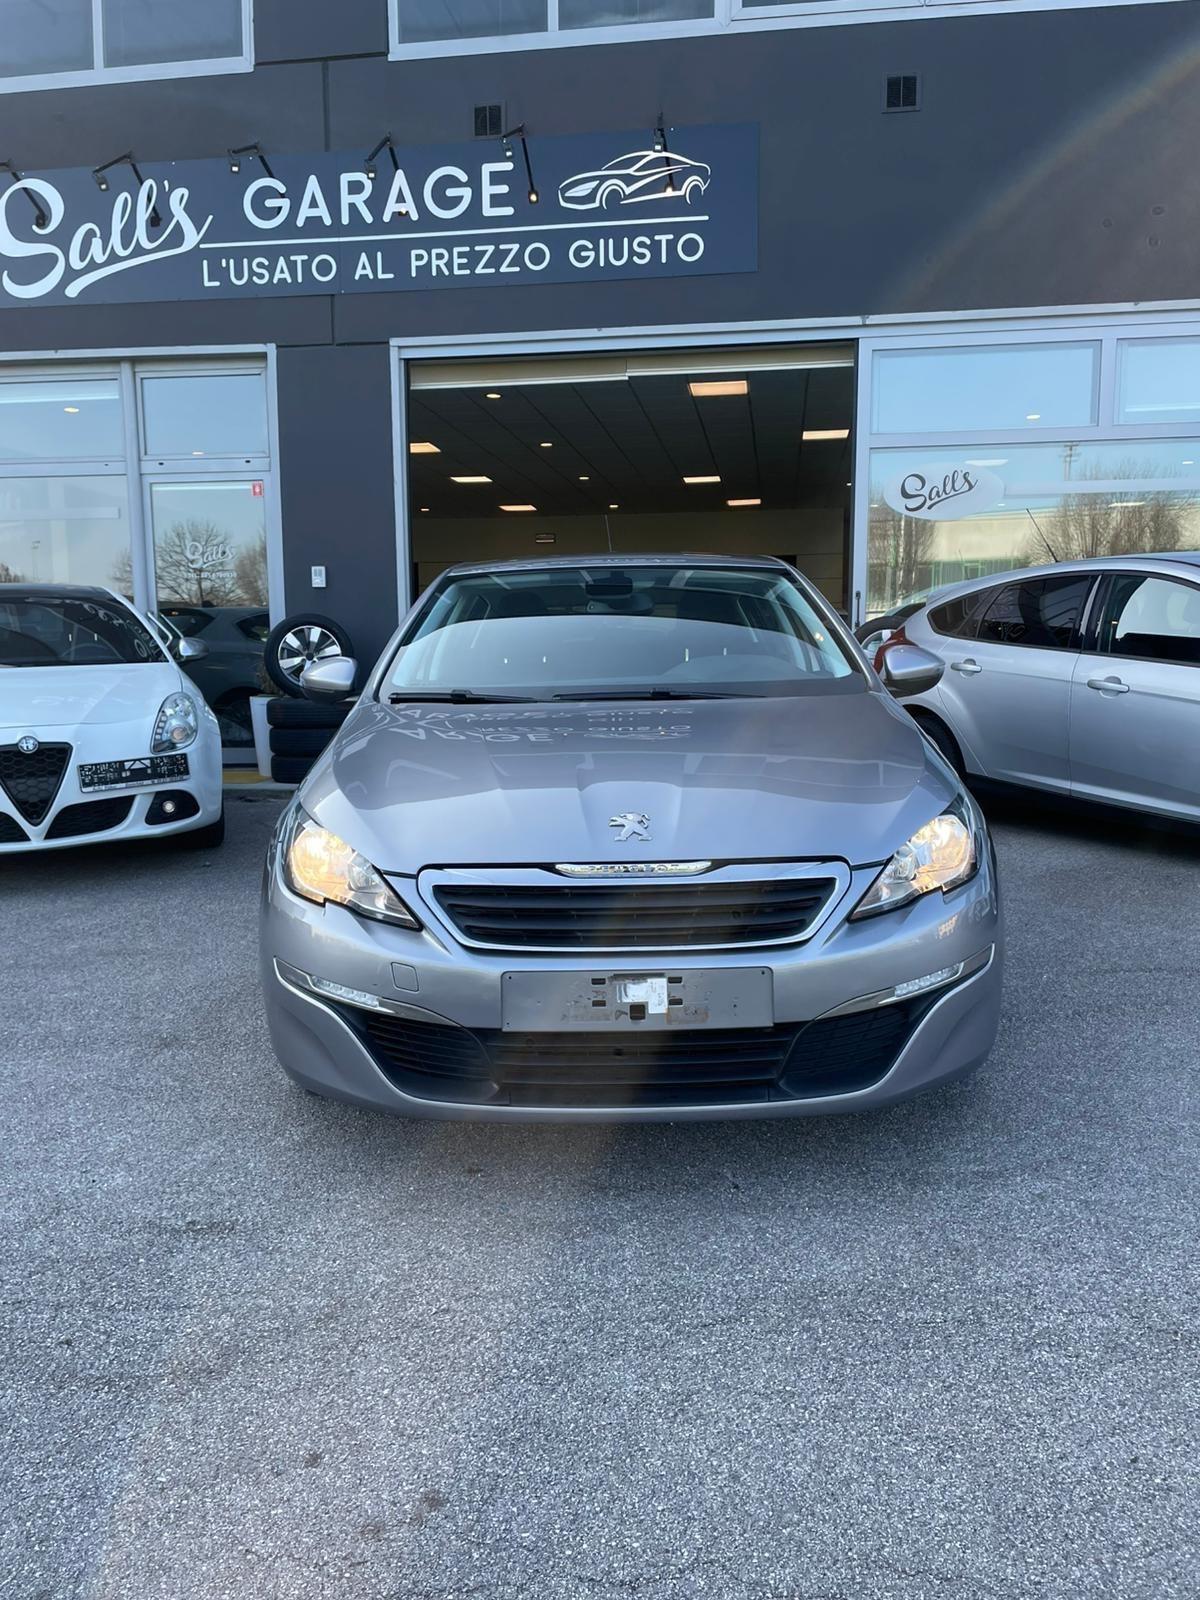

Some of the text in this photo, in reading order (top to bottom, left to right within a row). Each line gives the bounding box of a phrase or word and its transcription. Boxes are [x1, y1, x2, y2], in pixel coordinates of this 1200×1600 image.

[243, 162, 515, 229] GARAGE
[0, 178, 213, 298] Sall's
[202, 232, 705, 287] L'USATO AL PREZZO GIUSTO
[900, 469, 978, 512] Sall's
